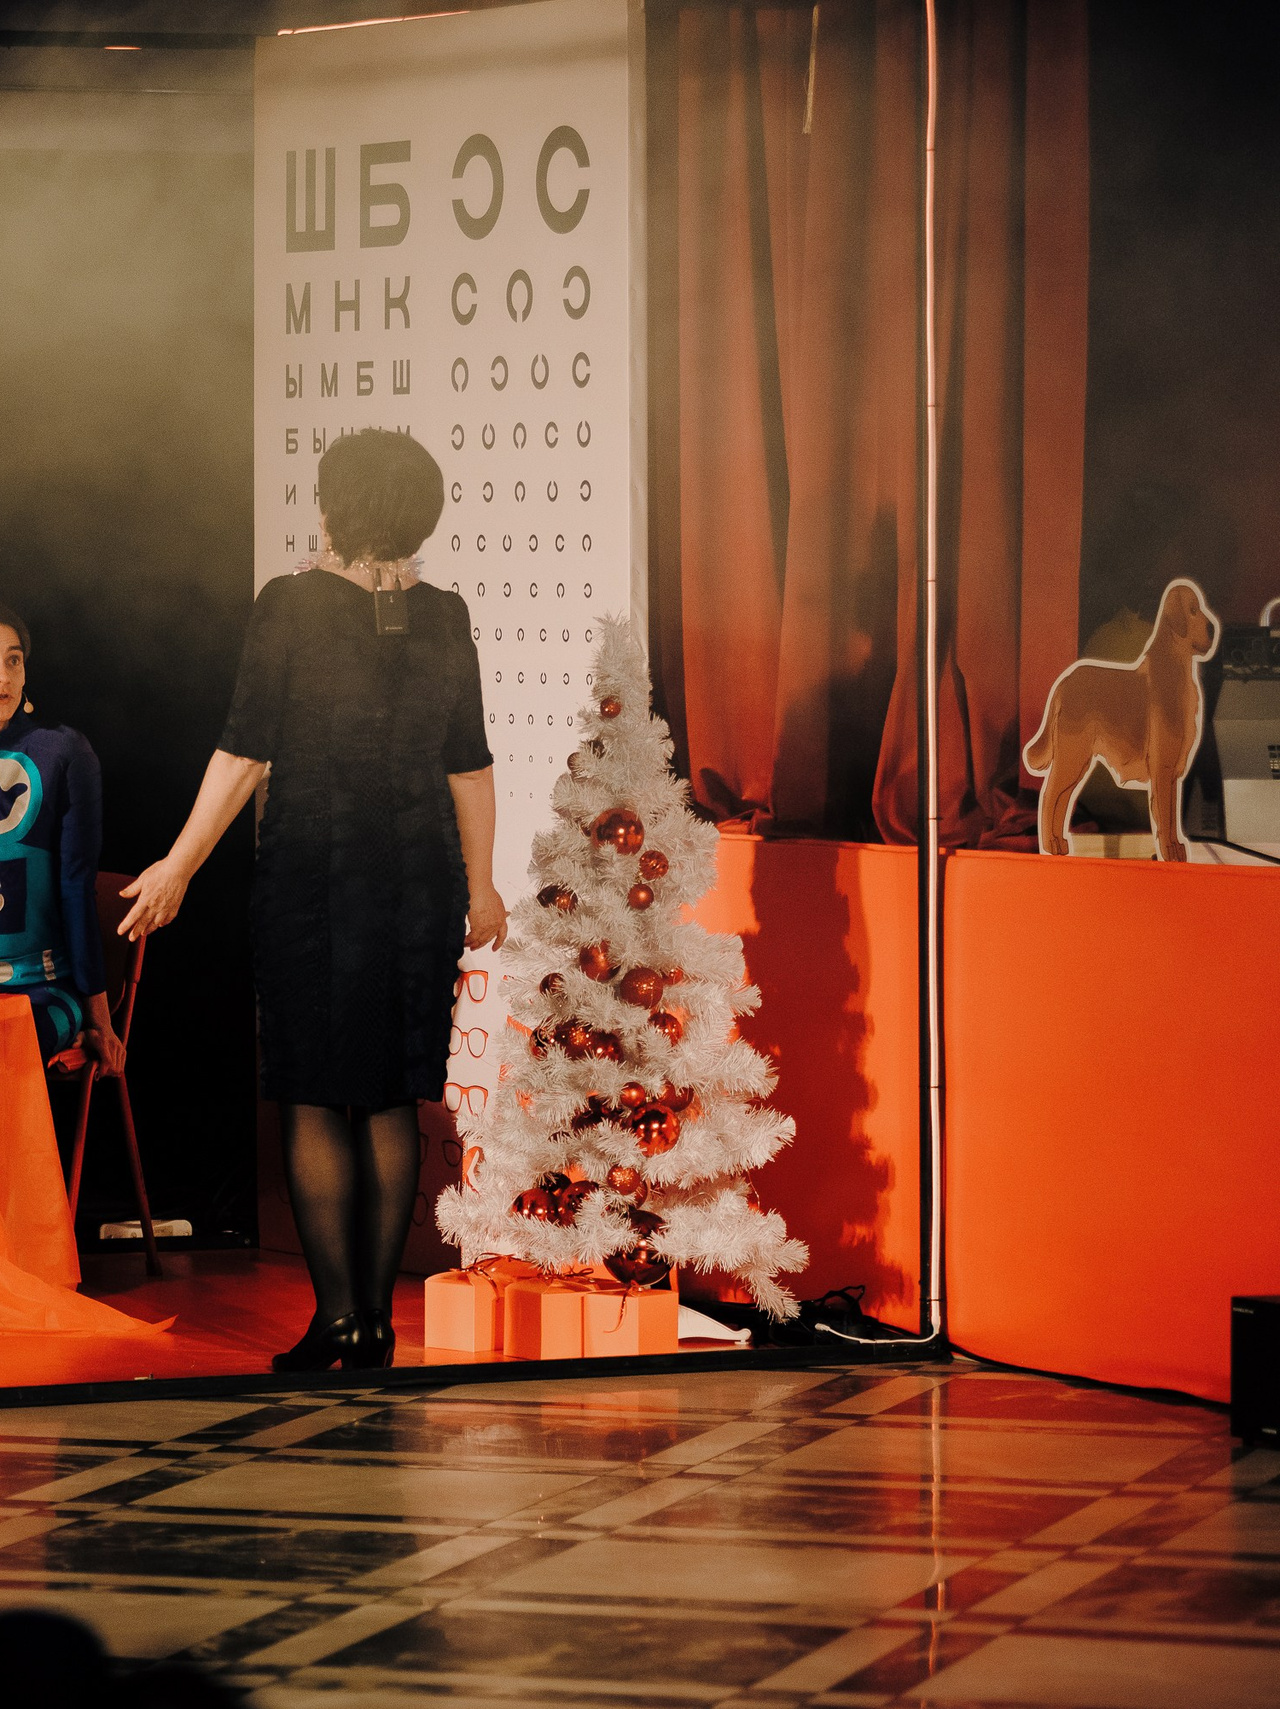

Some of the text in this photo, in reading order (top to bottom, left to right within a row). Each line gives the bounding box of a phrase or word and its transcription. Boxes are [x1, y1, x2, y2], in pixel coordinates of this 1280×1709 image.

[286, 140, 411, 253] Ш Б
[286, 276, 410, 334] М Н К
[286, 360, 410, 398] Ы М Б Ш
[286, 428, 326, 454] Б Ы
[286, 485, 296, 504] И
[286, 535, 317, 552] Н Ш
